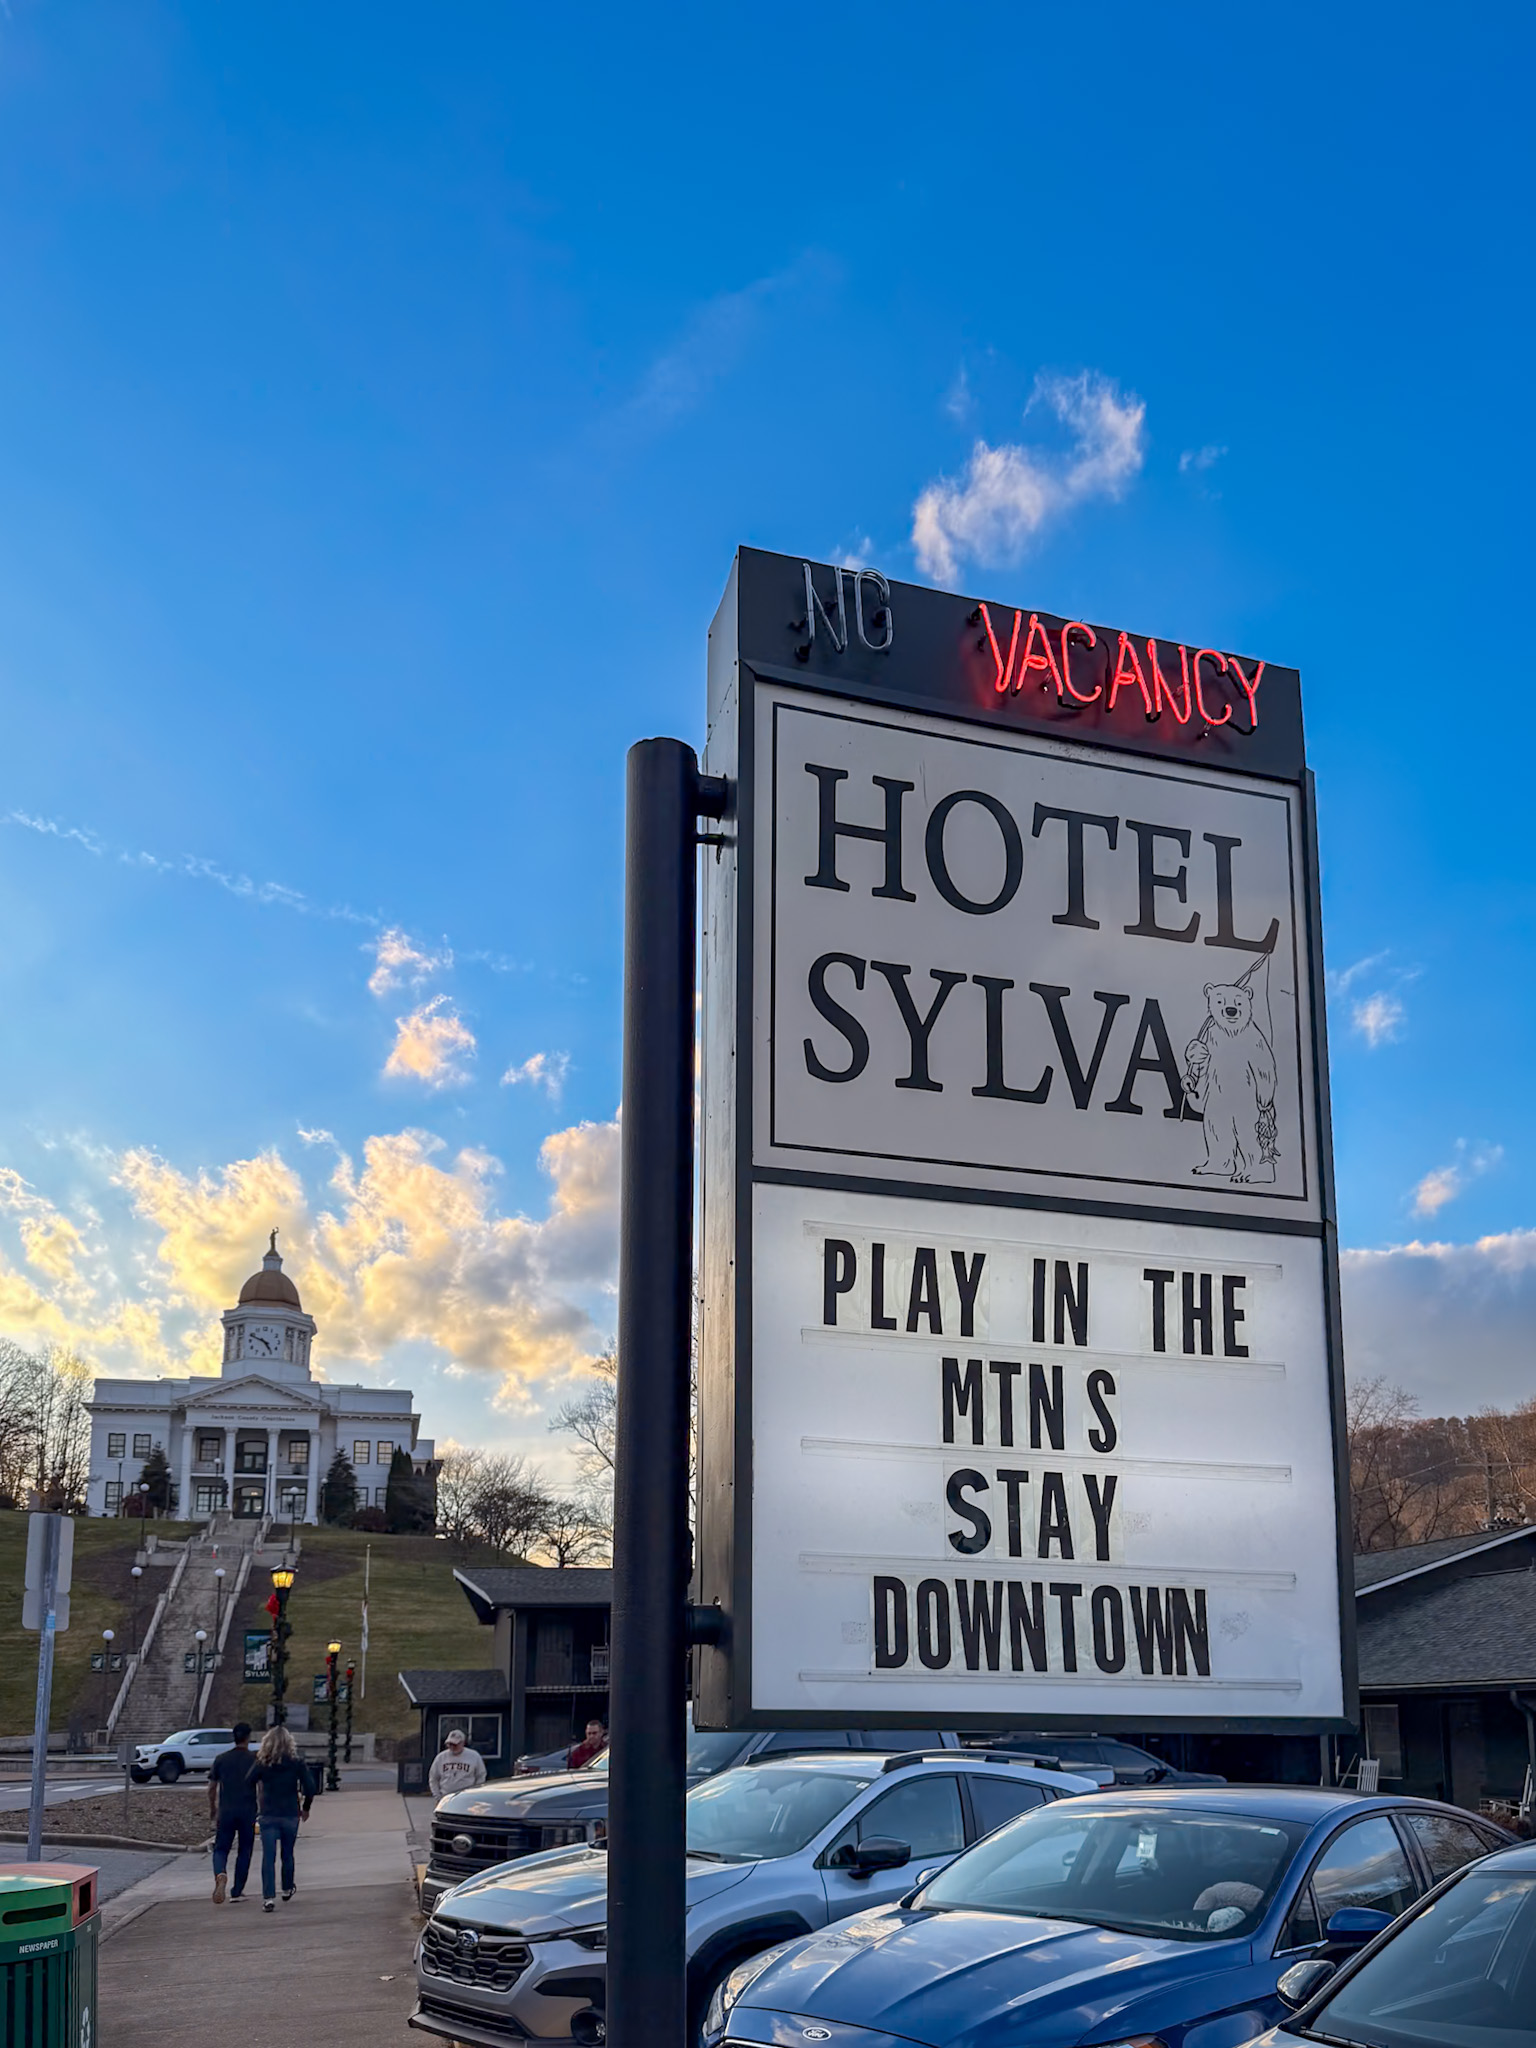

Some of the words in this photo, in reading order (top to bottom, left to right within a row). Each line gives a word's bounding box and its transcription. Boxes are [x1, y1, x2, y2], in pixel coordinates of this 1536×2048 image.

[978, 602, 1265, 728] VACANCY
[803, 762, 1279, 953] HOTEL
[802, 951, 1204, 1122] SYLVA
[823, 1238, 987, 1338] PLAY
[1032, 1257, 1090, 1347] IN
[1143, 1268, 1250, 1358] THE
[941, 1357, 1117, 1453] MTNS
[946, 1468, 1118, 1562] STAY
[244, 1670, 270, 1678] SYLVA
[873, 1575, 1211, 1677] DOWNTOWN
[443, 1762, 470, 1773] ETSU
[19, 1939, 59, 1954] NEWSPAPER
